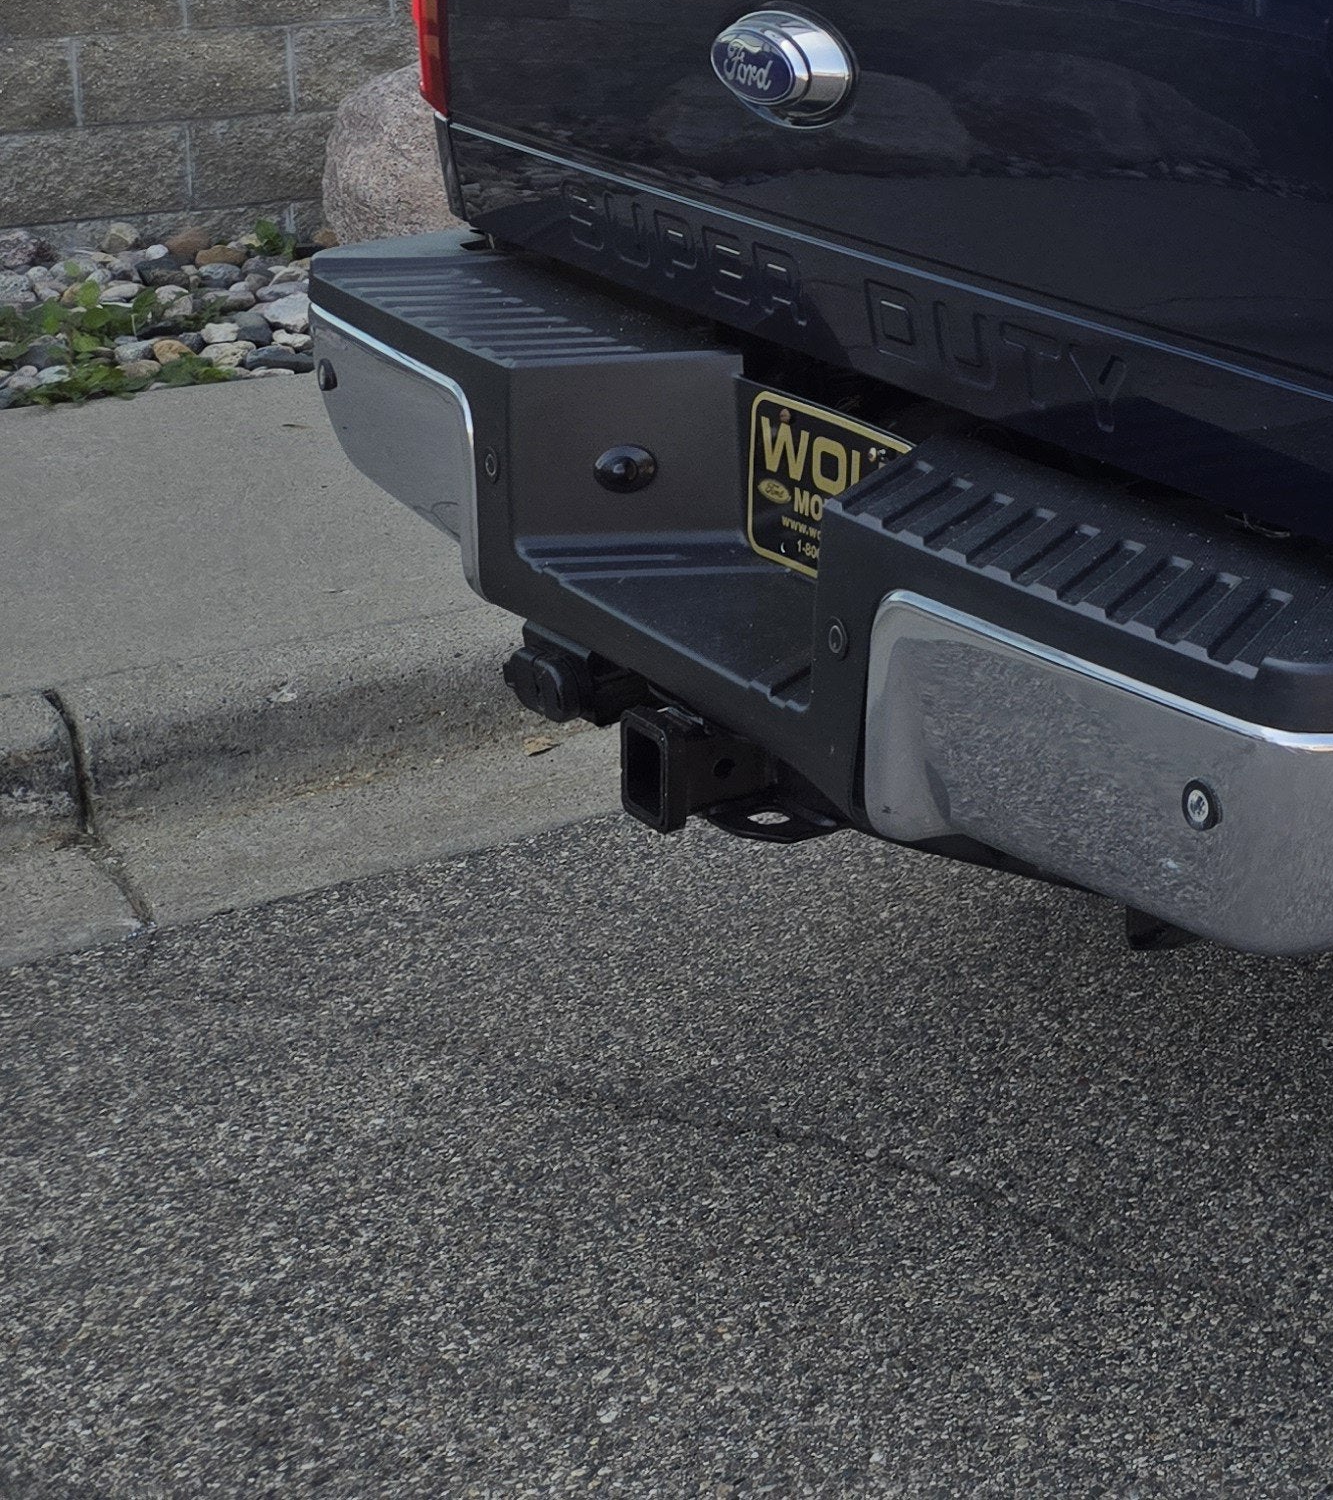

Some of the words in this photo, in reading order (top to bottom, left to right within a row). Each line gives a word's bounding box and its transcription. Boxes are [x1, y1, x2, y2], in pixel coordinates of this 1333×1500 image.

[723, 38, 774, 90] Ford
[562, 178, 808, 327] SUPER
[863, 278, 1129, 434] DUTY
